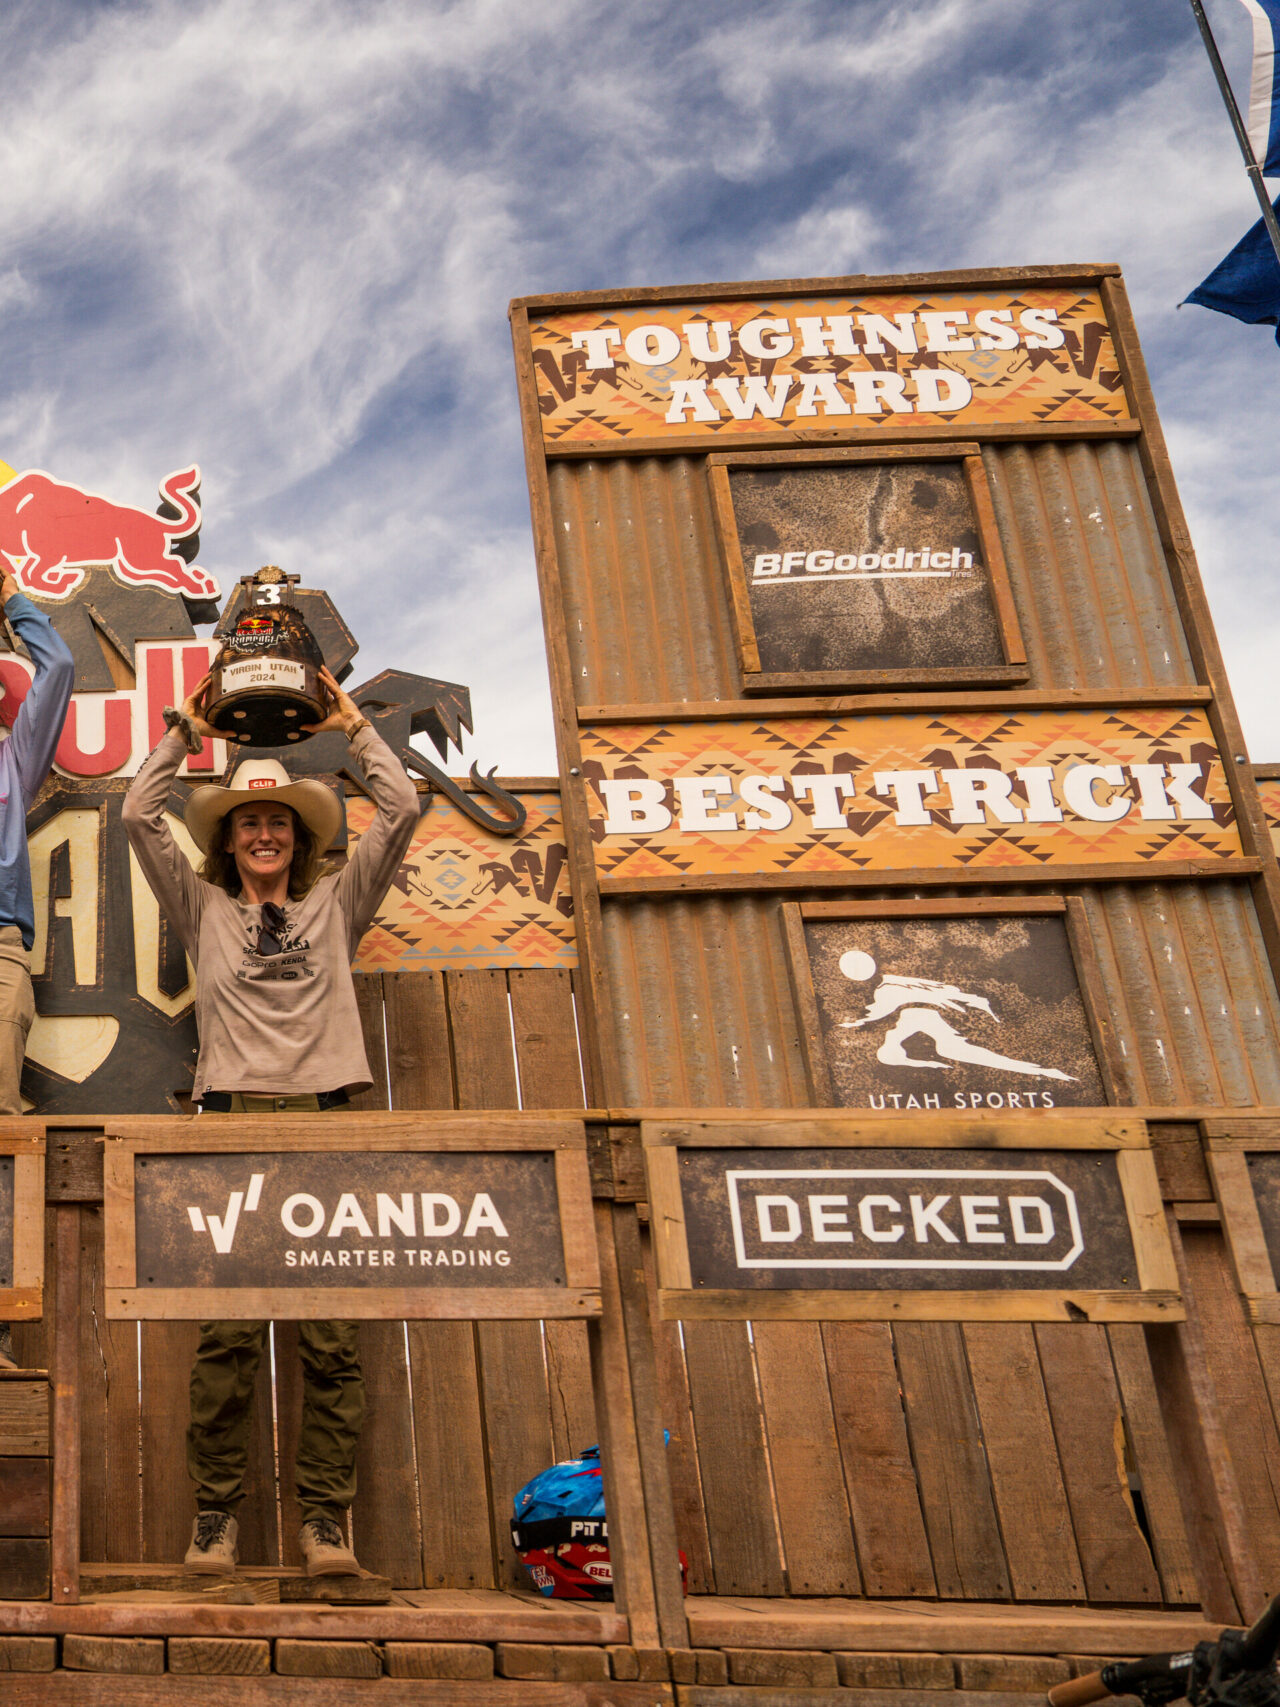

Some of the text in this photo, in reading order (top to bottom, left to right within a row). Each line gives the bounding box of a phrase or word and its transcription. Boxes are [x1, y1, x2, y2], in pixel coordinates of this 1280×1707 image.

[572, 309, 1066, 371] TOUGHNESS
[665, 369, 974, 424] AWARD
[753, 547, 973, 577] BFGoodrich
[951, 569, 972, 578] Tires
[256, 583, 280, 605] 3
[230, 663, 297, 676] VIRGIN UTAH
[250, 673, 276, 682] 2024
[252, 780, 274, 788] CLIF
[599, 764, 1215, 835] BEST TRICK
[281, 955, 307, 966] KENDA
[869, 1091, 1054, 1109] UTAH SPORTS
[281, 1192, 509, 1238] OANDA
[755, 1193, 1055, 1245] DECKED
[285, 1249, 511, 1267] SMARTER TRADING
[588, 1566, 613, 1578] BEL
